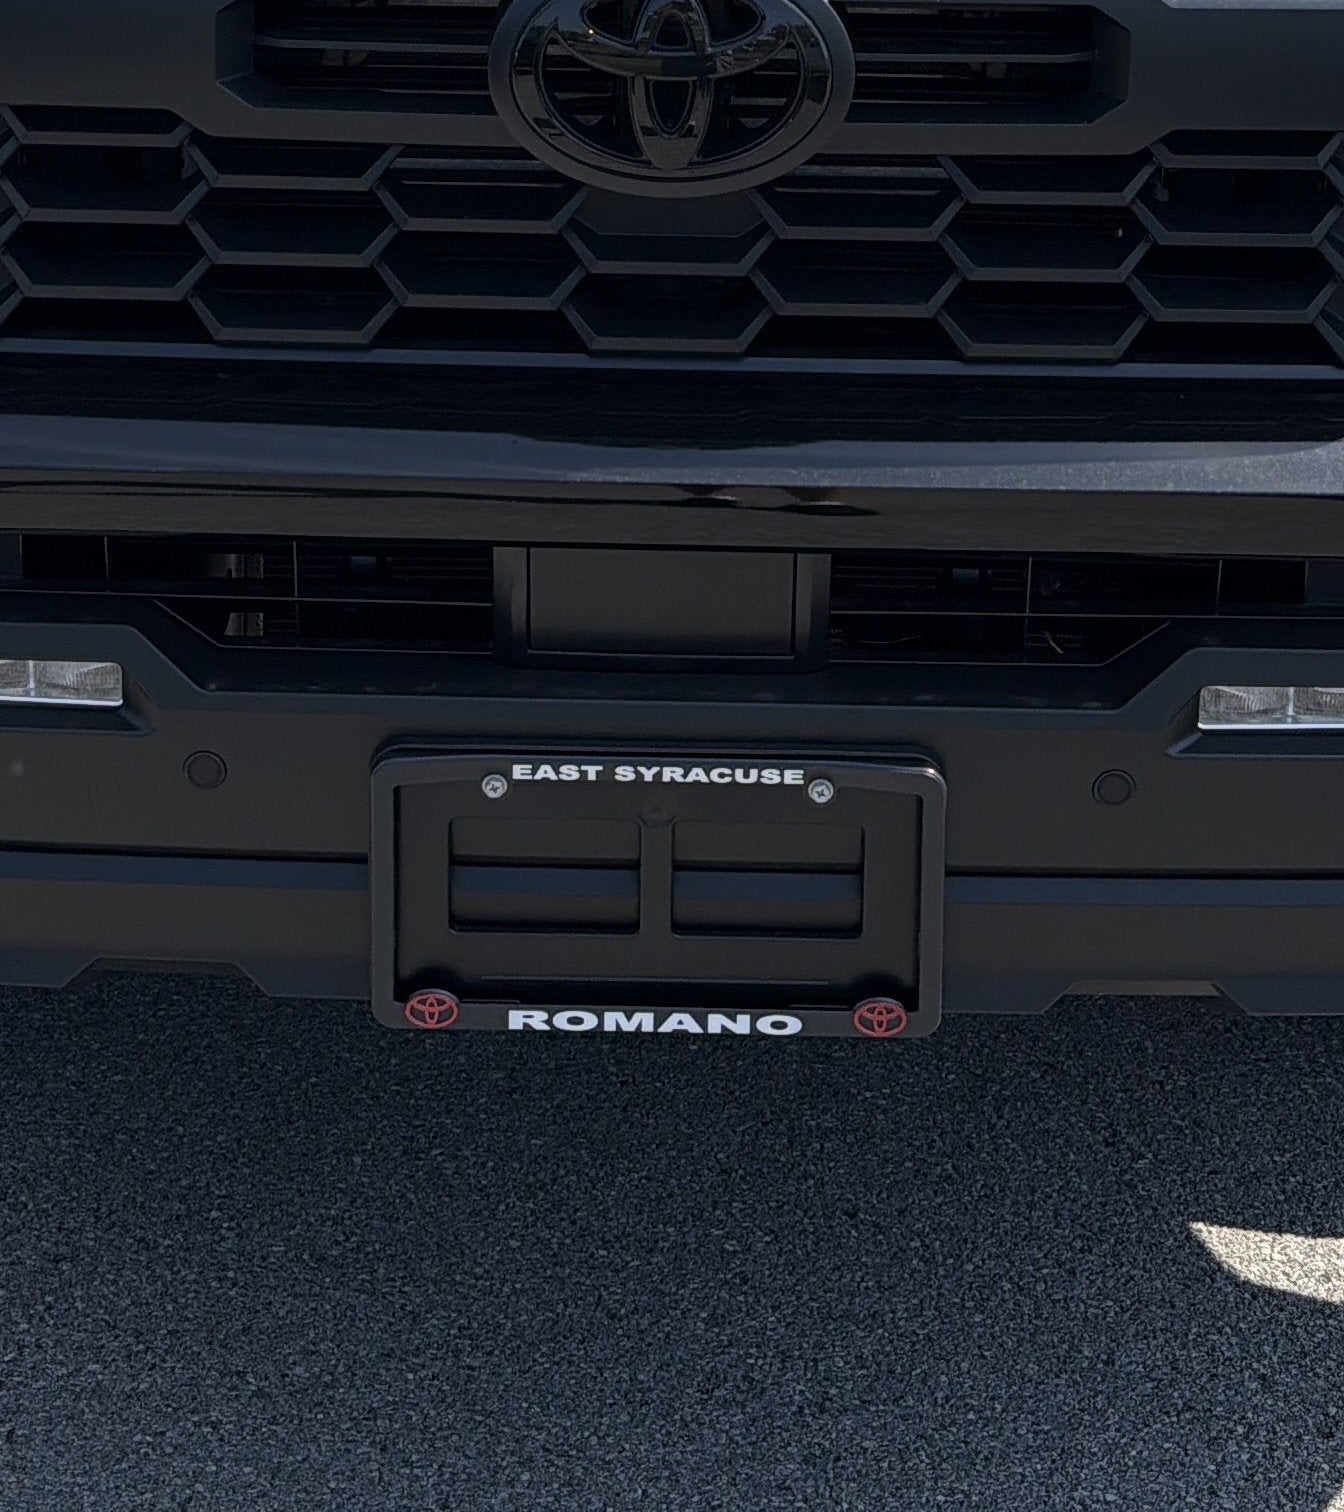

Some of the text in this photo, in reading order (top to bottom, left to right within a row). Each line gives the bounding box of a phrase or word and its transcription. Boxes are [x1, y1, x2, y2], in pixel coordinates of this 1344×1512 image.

[512, 764, 805, 785] EAST SYRACUSE
[508, 1009, 803, 1036] ROMANO
